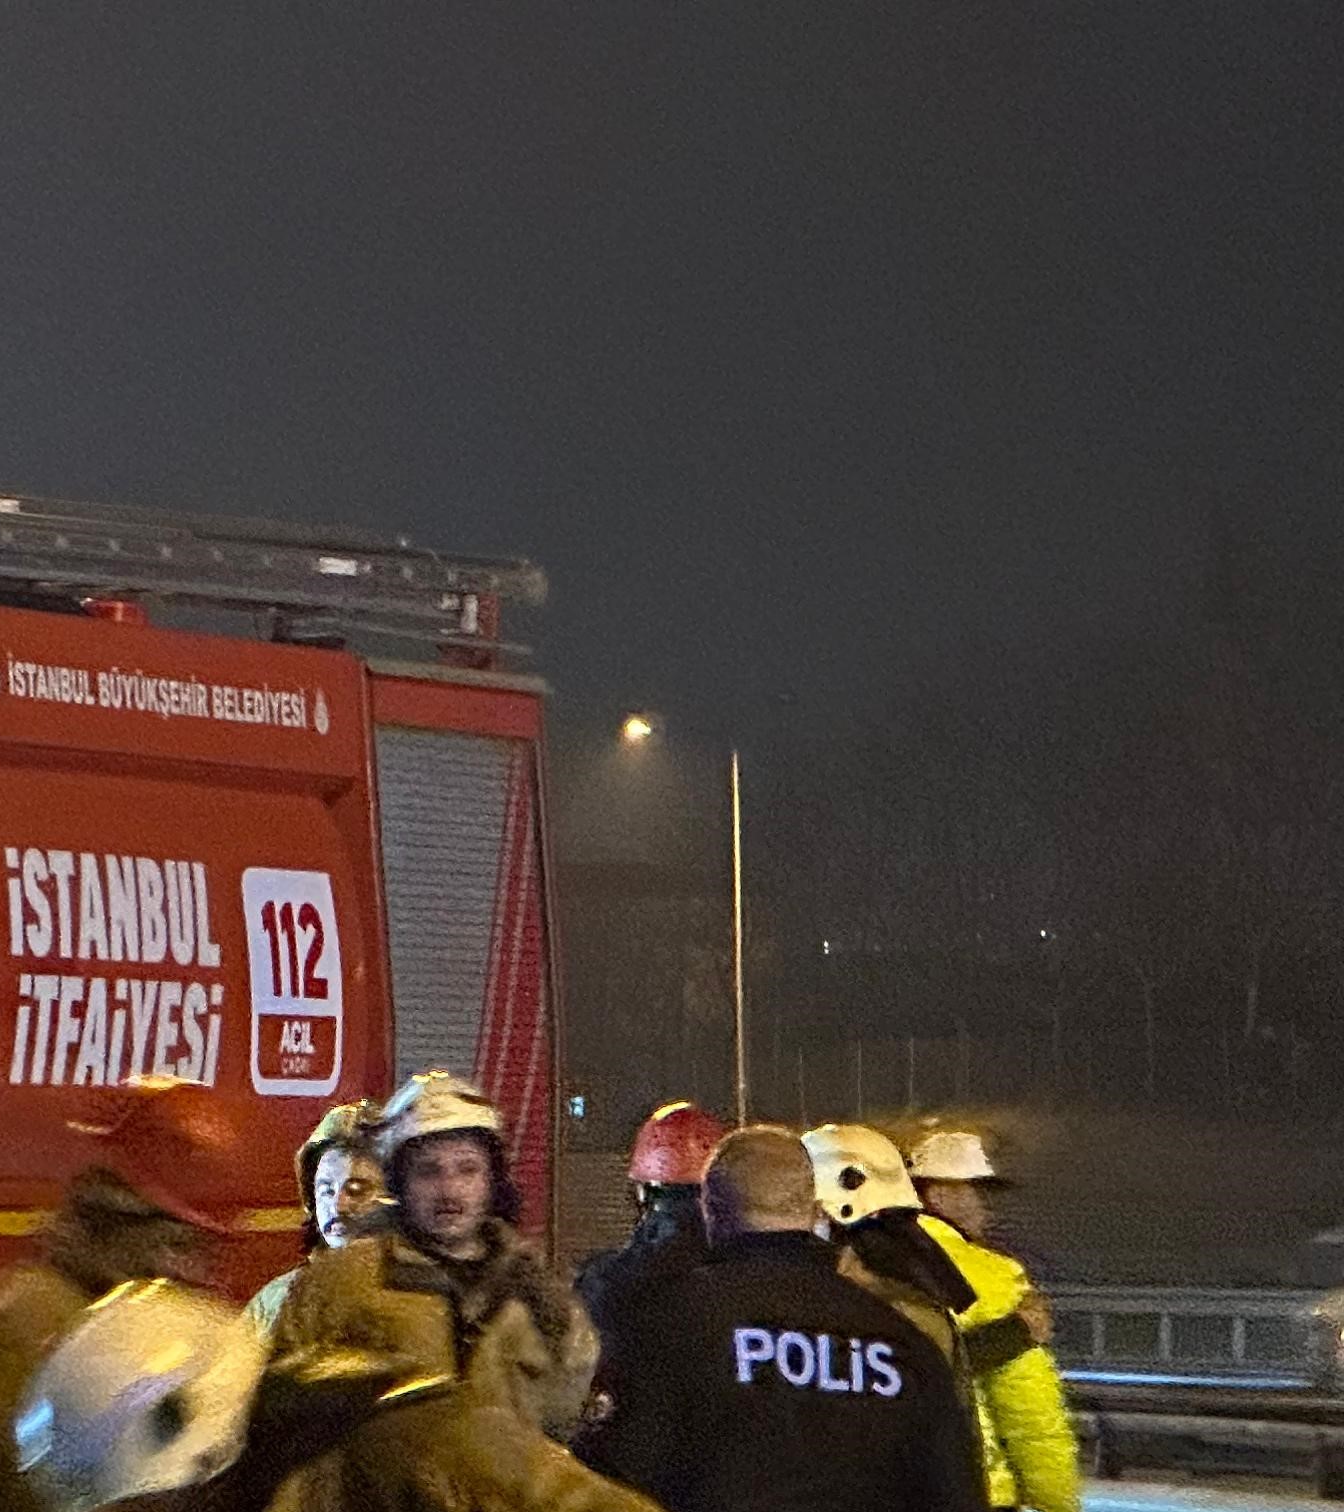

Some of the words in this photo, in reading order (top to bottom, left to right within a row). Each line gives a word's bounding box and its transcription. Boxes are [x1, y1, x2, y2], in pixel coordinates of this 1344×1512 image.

[8, 653, 95, 705] İSTANBUL
[98, 667, 210, 719] BÜYÜKŞEHİR
[213, 682, 307, 728] BELEDİYESİ
[5, 847, 221, 967] İSTANBUL
[261, 900, 329, 1000] 112
